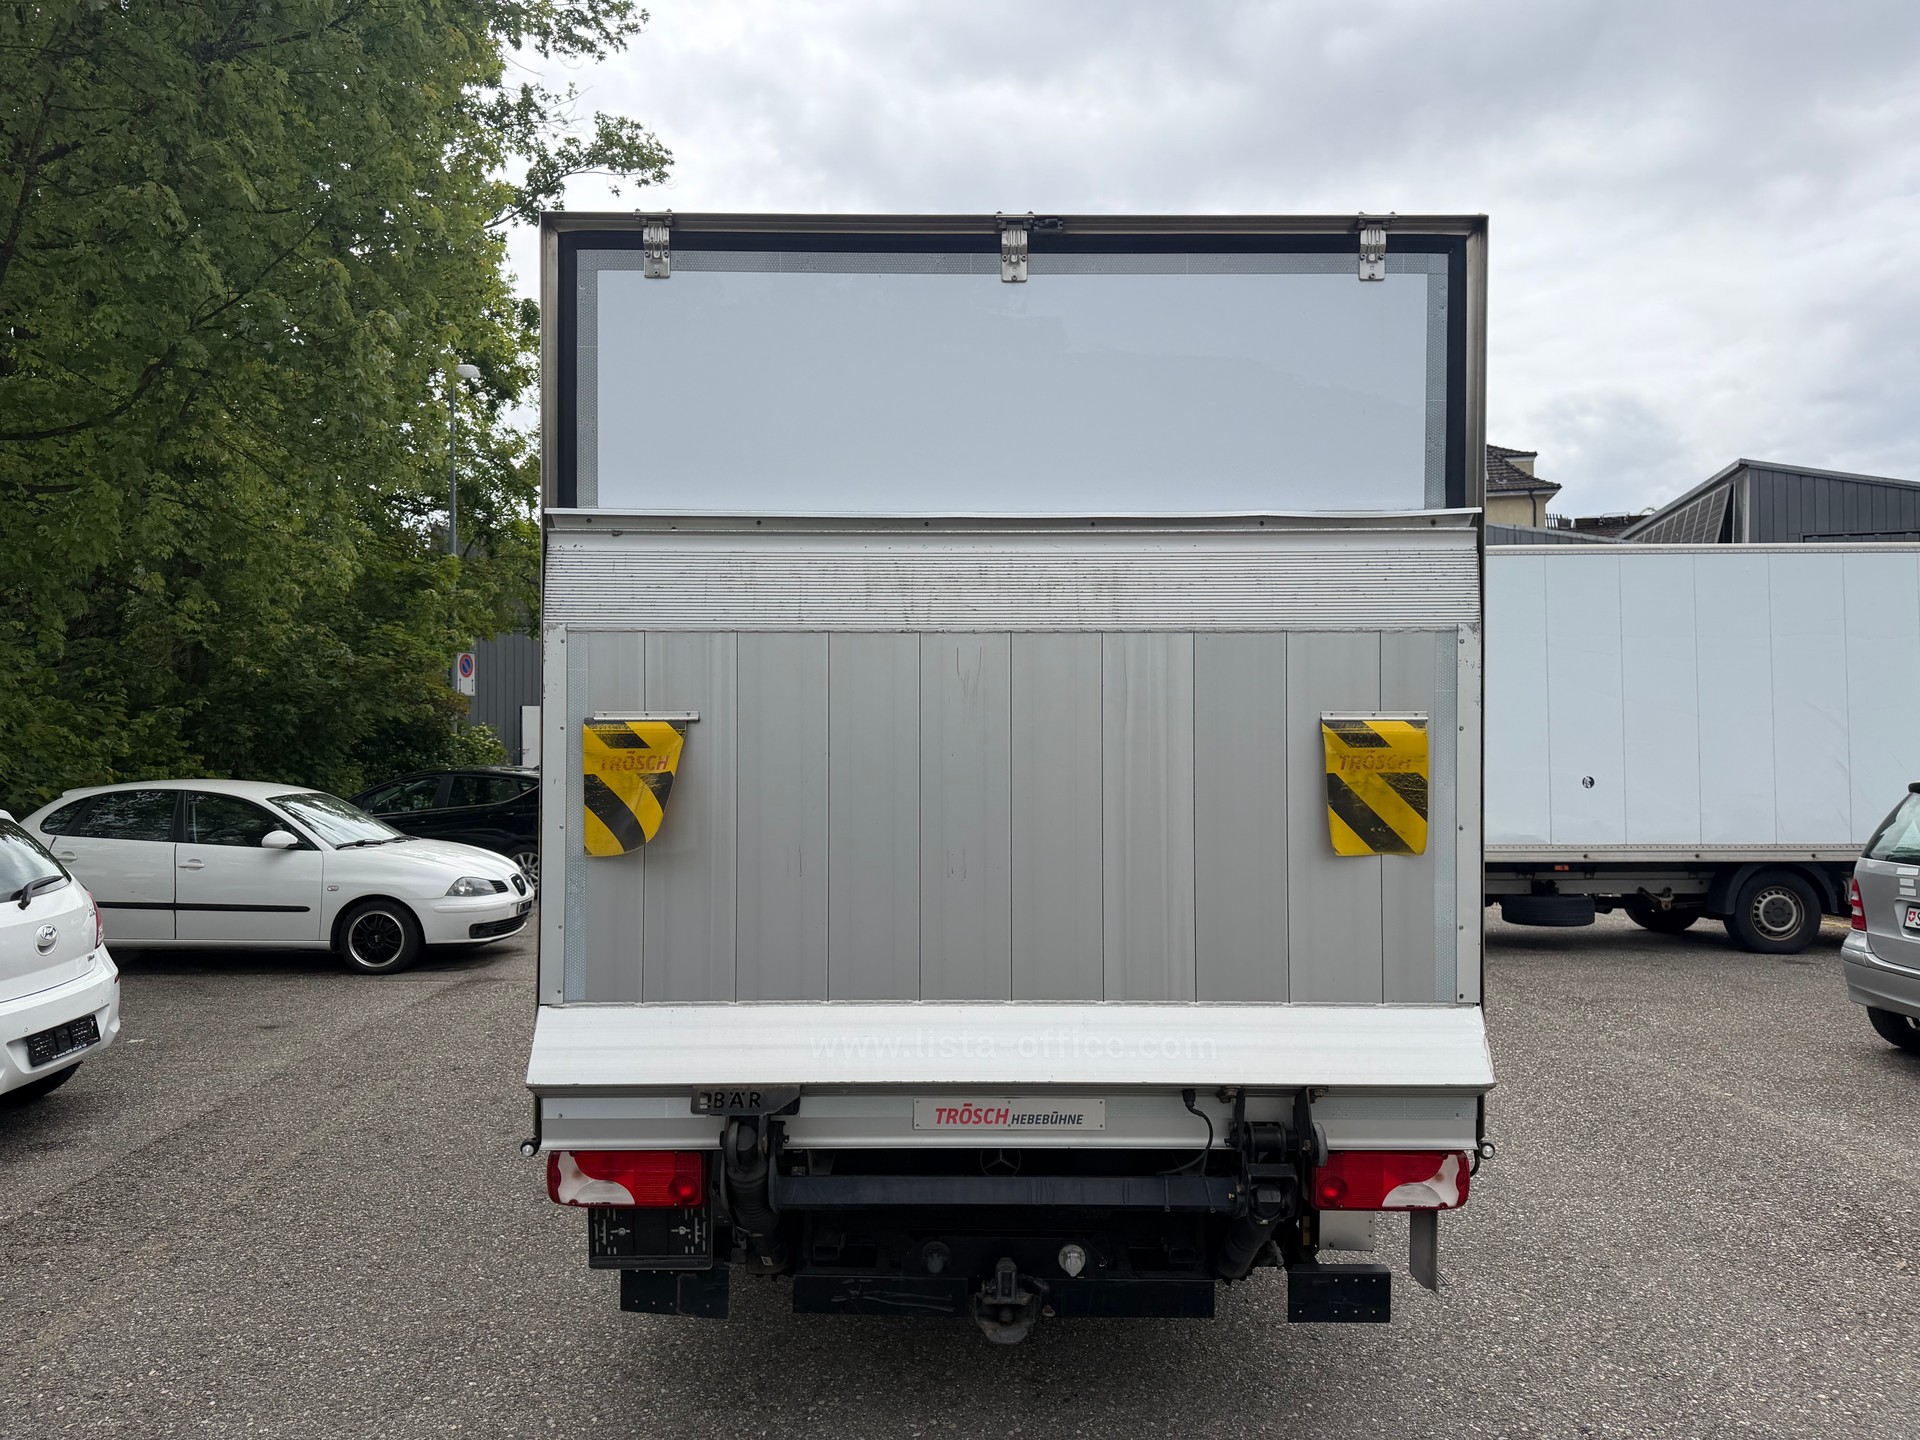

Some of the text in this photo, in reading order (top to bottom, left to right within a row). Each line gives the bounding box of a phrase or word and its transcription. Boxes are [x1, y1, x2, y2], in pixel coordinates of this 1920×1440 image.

[600, 751, 670, 771] TRÖSCH
[809, 1028, 1219, 1059] www.lista-office.com
[713, 1092, 761, 1109] BÄR
[935, 1103, 1084, 1125] TRÖSCH HEBEBÜHNE
